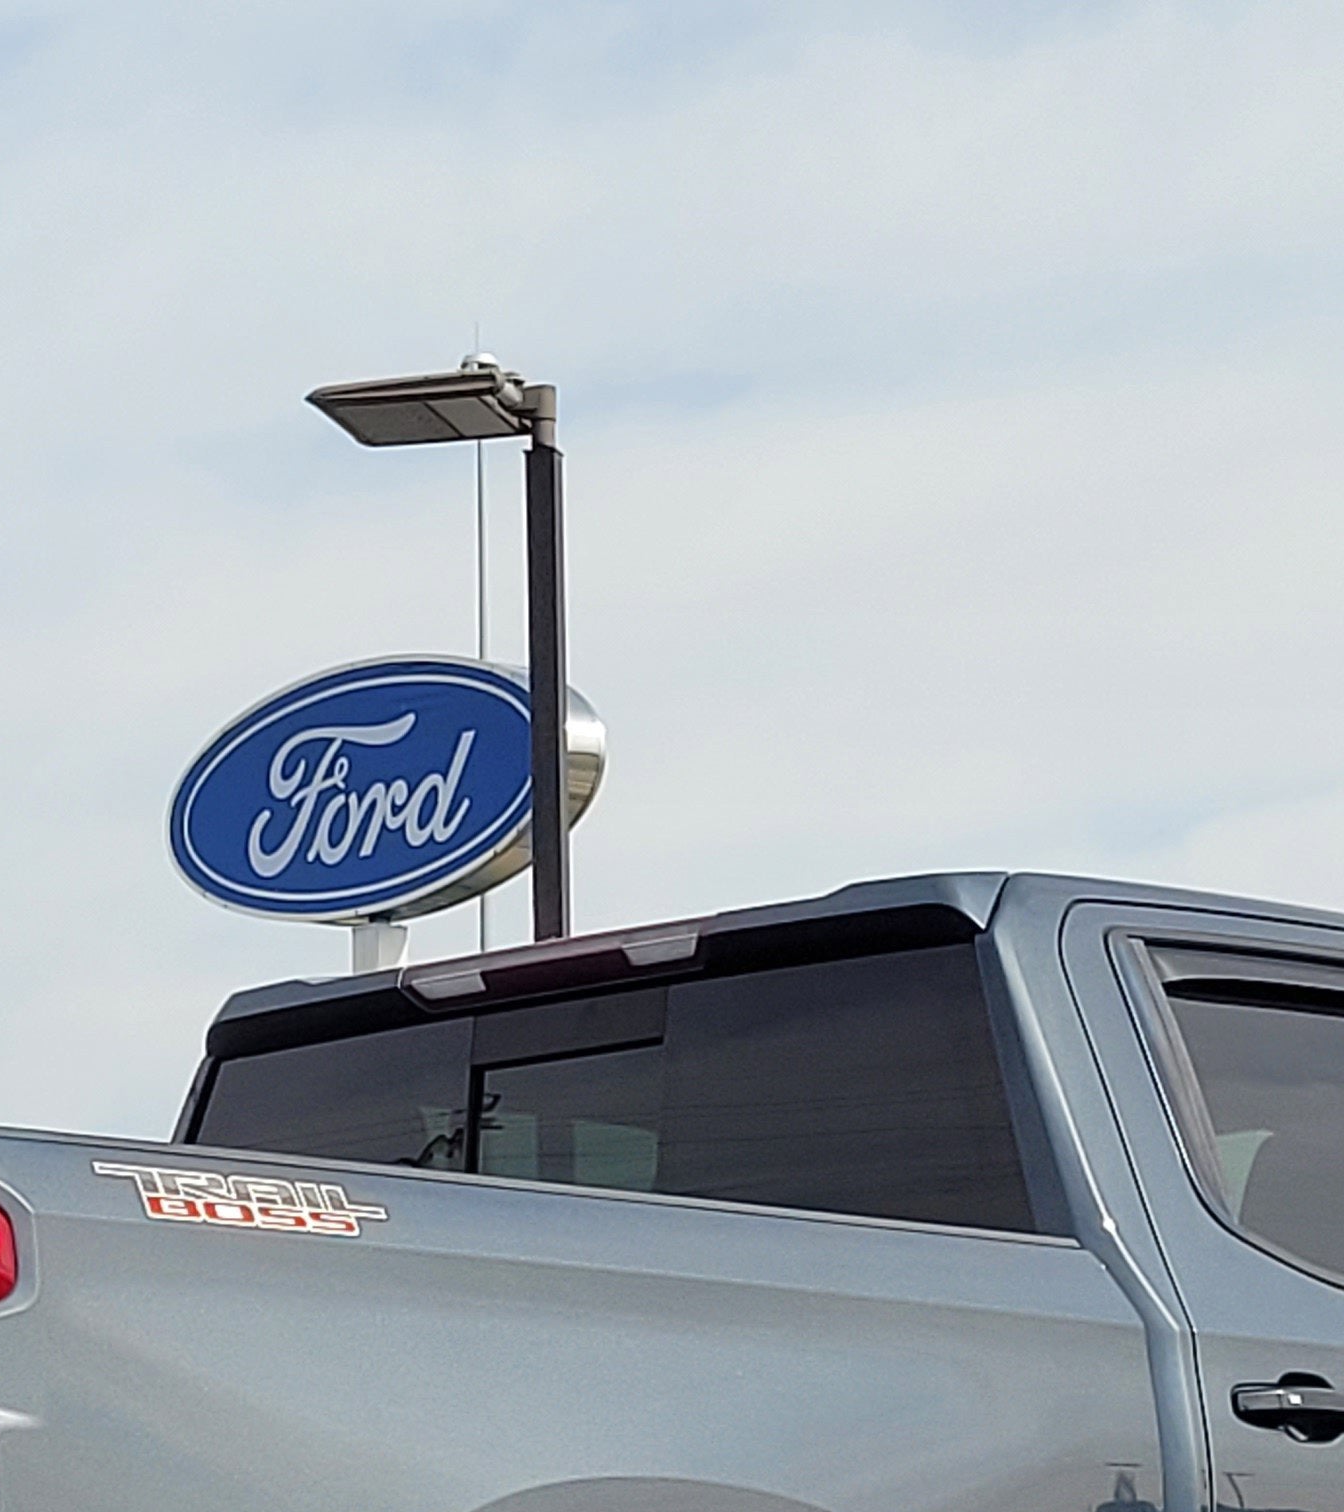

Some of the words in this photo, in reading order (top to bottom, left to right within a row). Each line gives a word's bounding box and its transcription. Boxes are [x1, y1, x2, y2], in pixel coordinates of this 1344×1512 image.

[248, 712, 477, 878] Ford
[91, 1160, 388, 1221] TRAIL
[146, 1195, 361, 1236] BOSS
